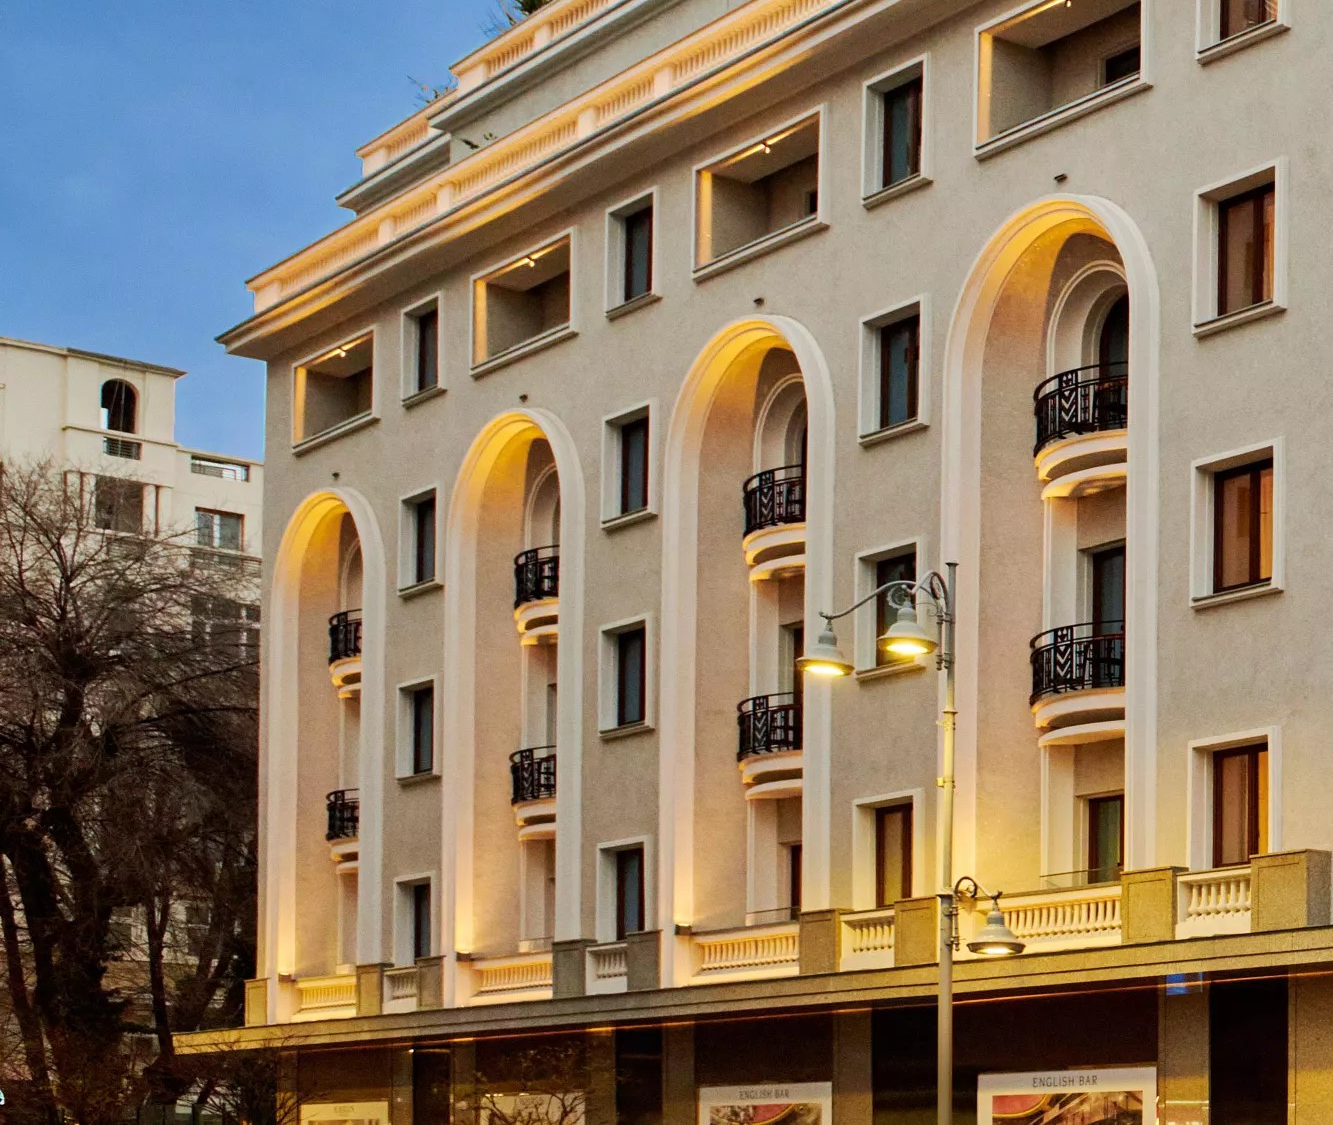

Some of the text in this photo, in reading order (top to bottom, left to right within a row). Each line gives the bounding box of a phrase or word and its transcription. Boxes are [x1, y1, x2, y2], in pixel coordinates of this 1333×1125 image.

[1032, 1075, 1098, 1088] ENGLISH BAR
[739, 1088, 790, 1100] ENGLISH BAR
